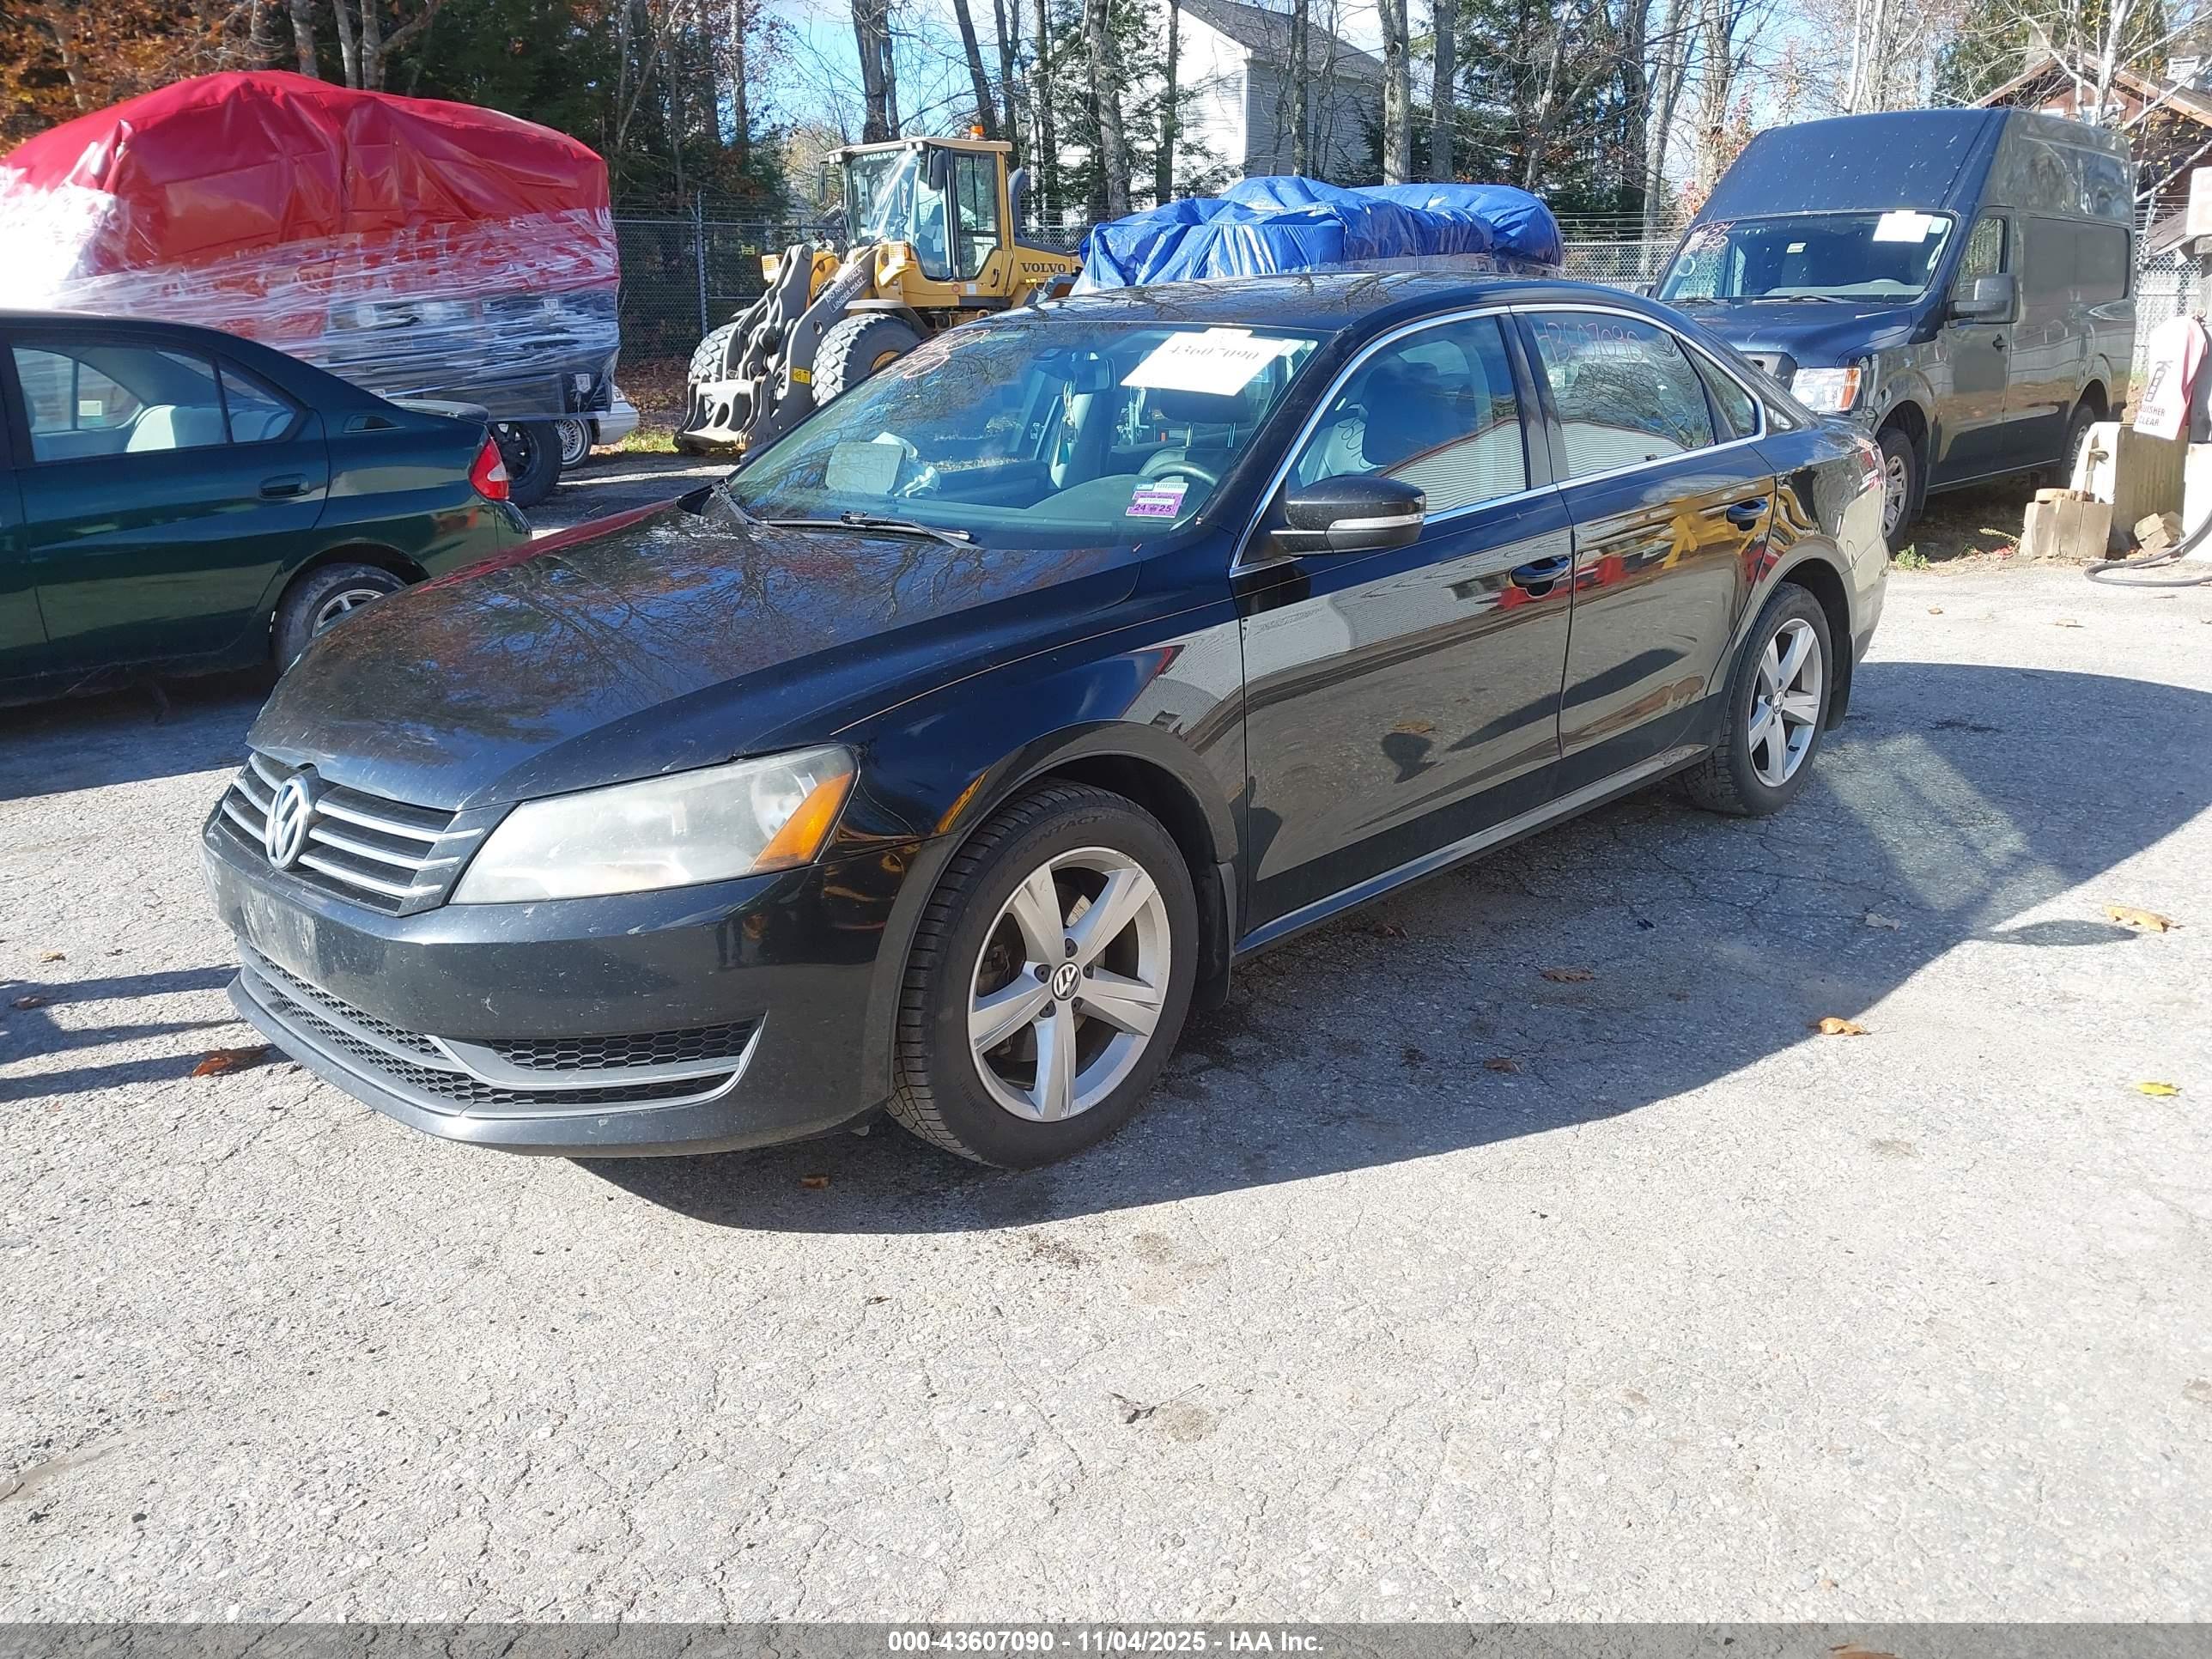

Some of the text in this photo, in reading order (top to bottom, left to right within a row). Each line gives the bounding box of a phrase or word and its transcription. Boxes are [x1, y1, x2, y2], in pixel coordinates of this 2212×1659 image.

[863, 151, 896, 161] VOLVO
[1020, 262, 1066, 273] VOLVO
[825, 264, 864, 303] DO NOT WALK
[832, 276, 864, 309] UNDER MAST
